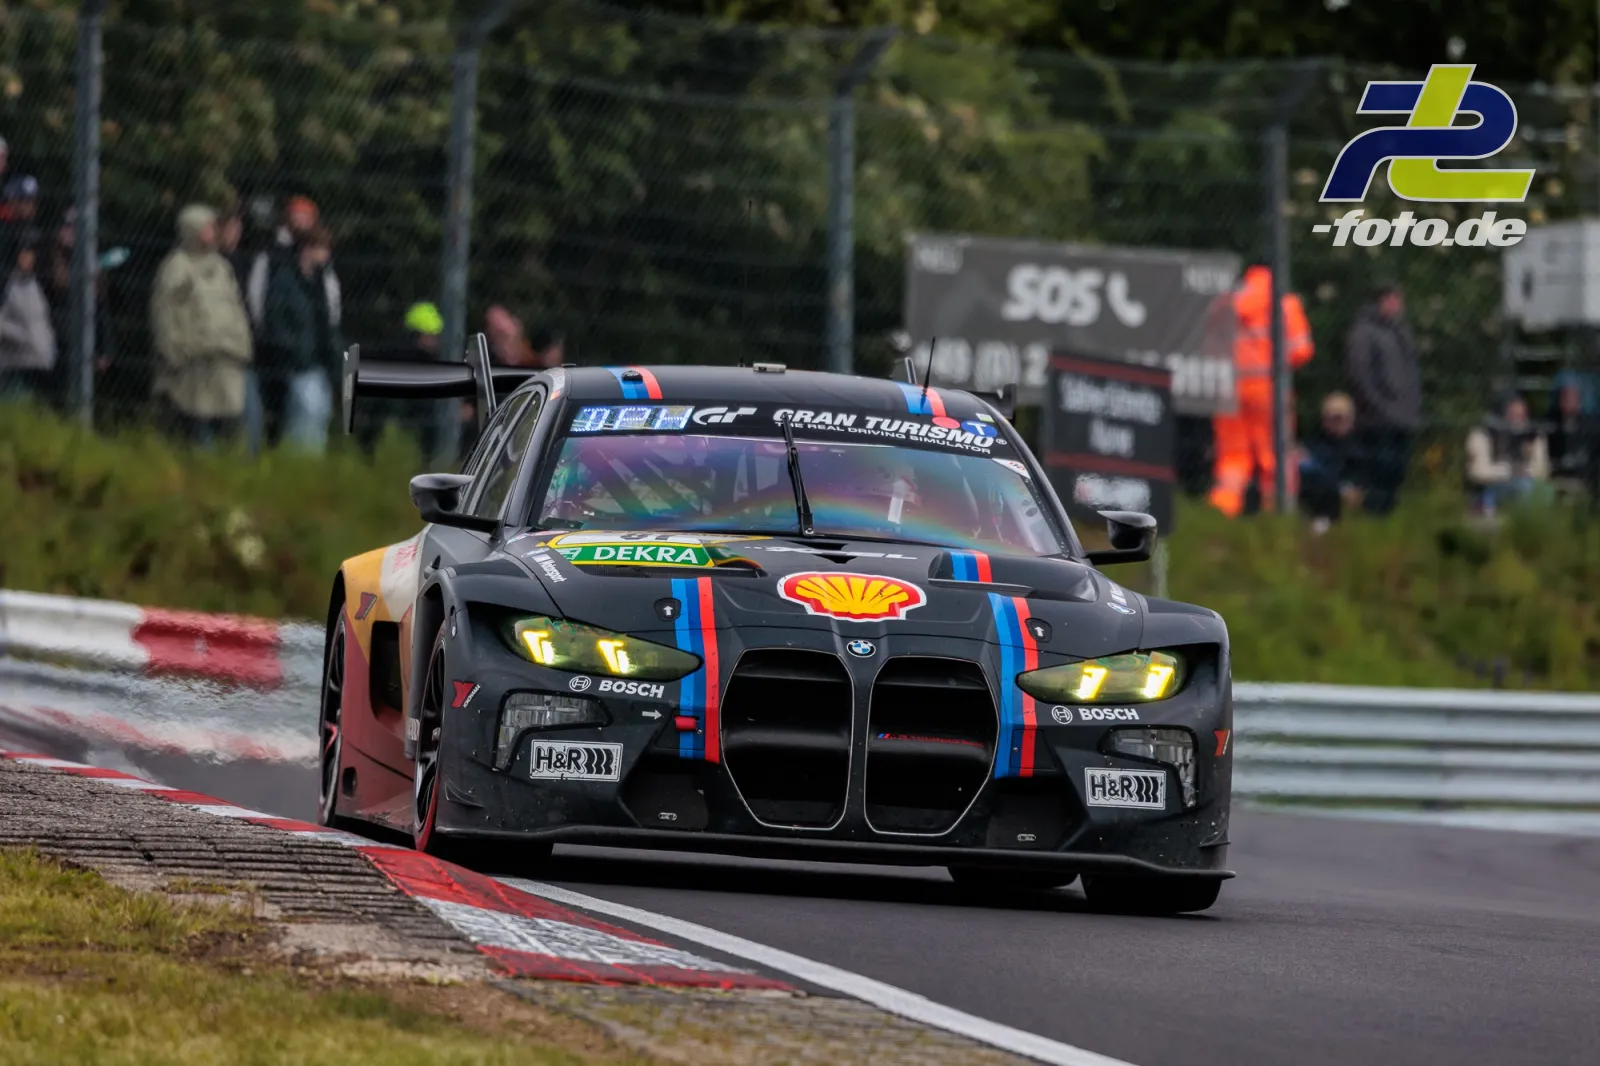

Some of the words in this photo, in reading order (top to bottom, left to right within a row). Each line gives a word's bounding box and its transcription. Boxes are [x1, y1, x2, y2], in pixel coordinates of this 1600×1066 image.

[1002, 262, 1104, 327] SOS
[772, 408, 858, 428] GRAN
[806, 421, 845, 432] REAL
[847, 426, 906, 440] DRIVING
[909, 435, 991, 455] SIMULATOR
[593, 546, 699, 565] DEKRA
[598, 680, 665, 699] BOSCH
[1078, 708, 1140, 721] BOSCH
[535, 745, 586, 774] H&R
[1090, 773, 1137, 802] H&R
